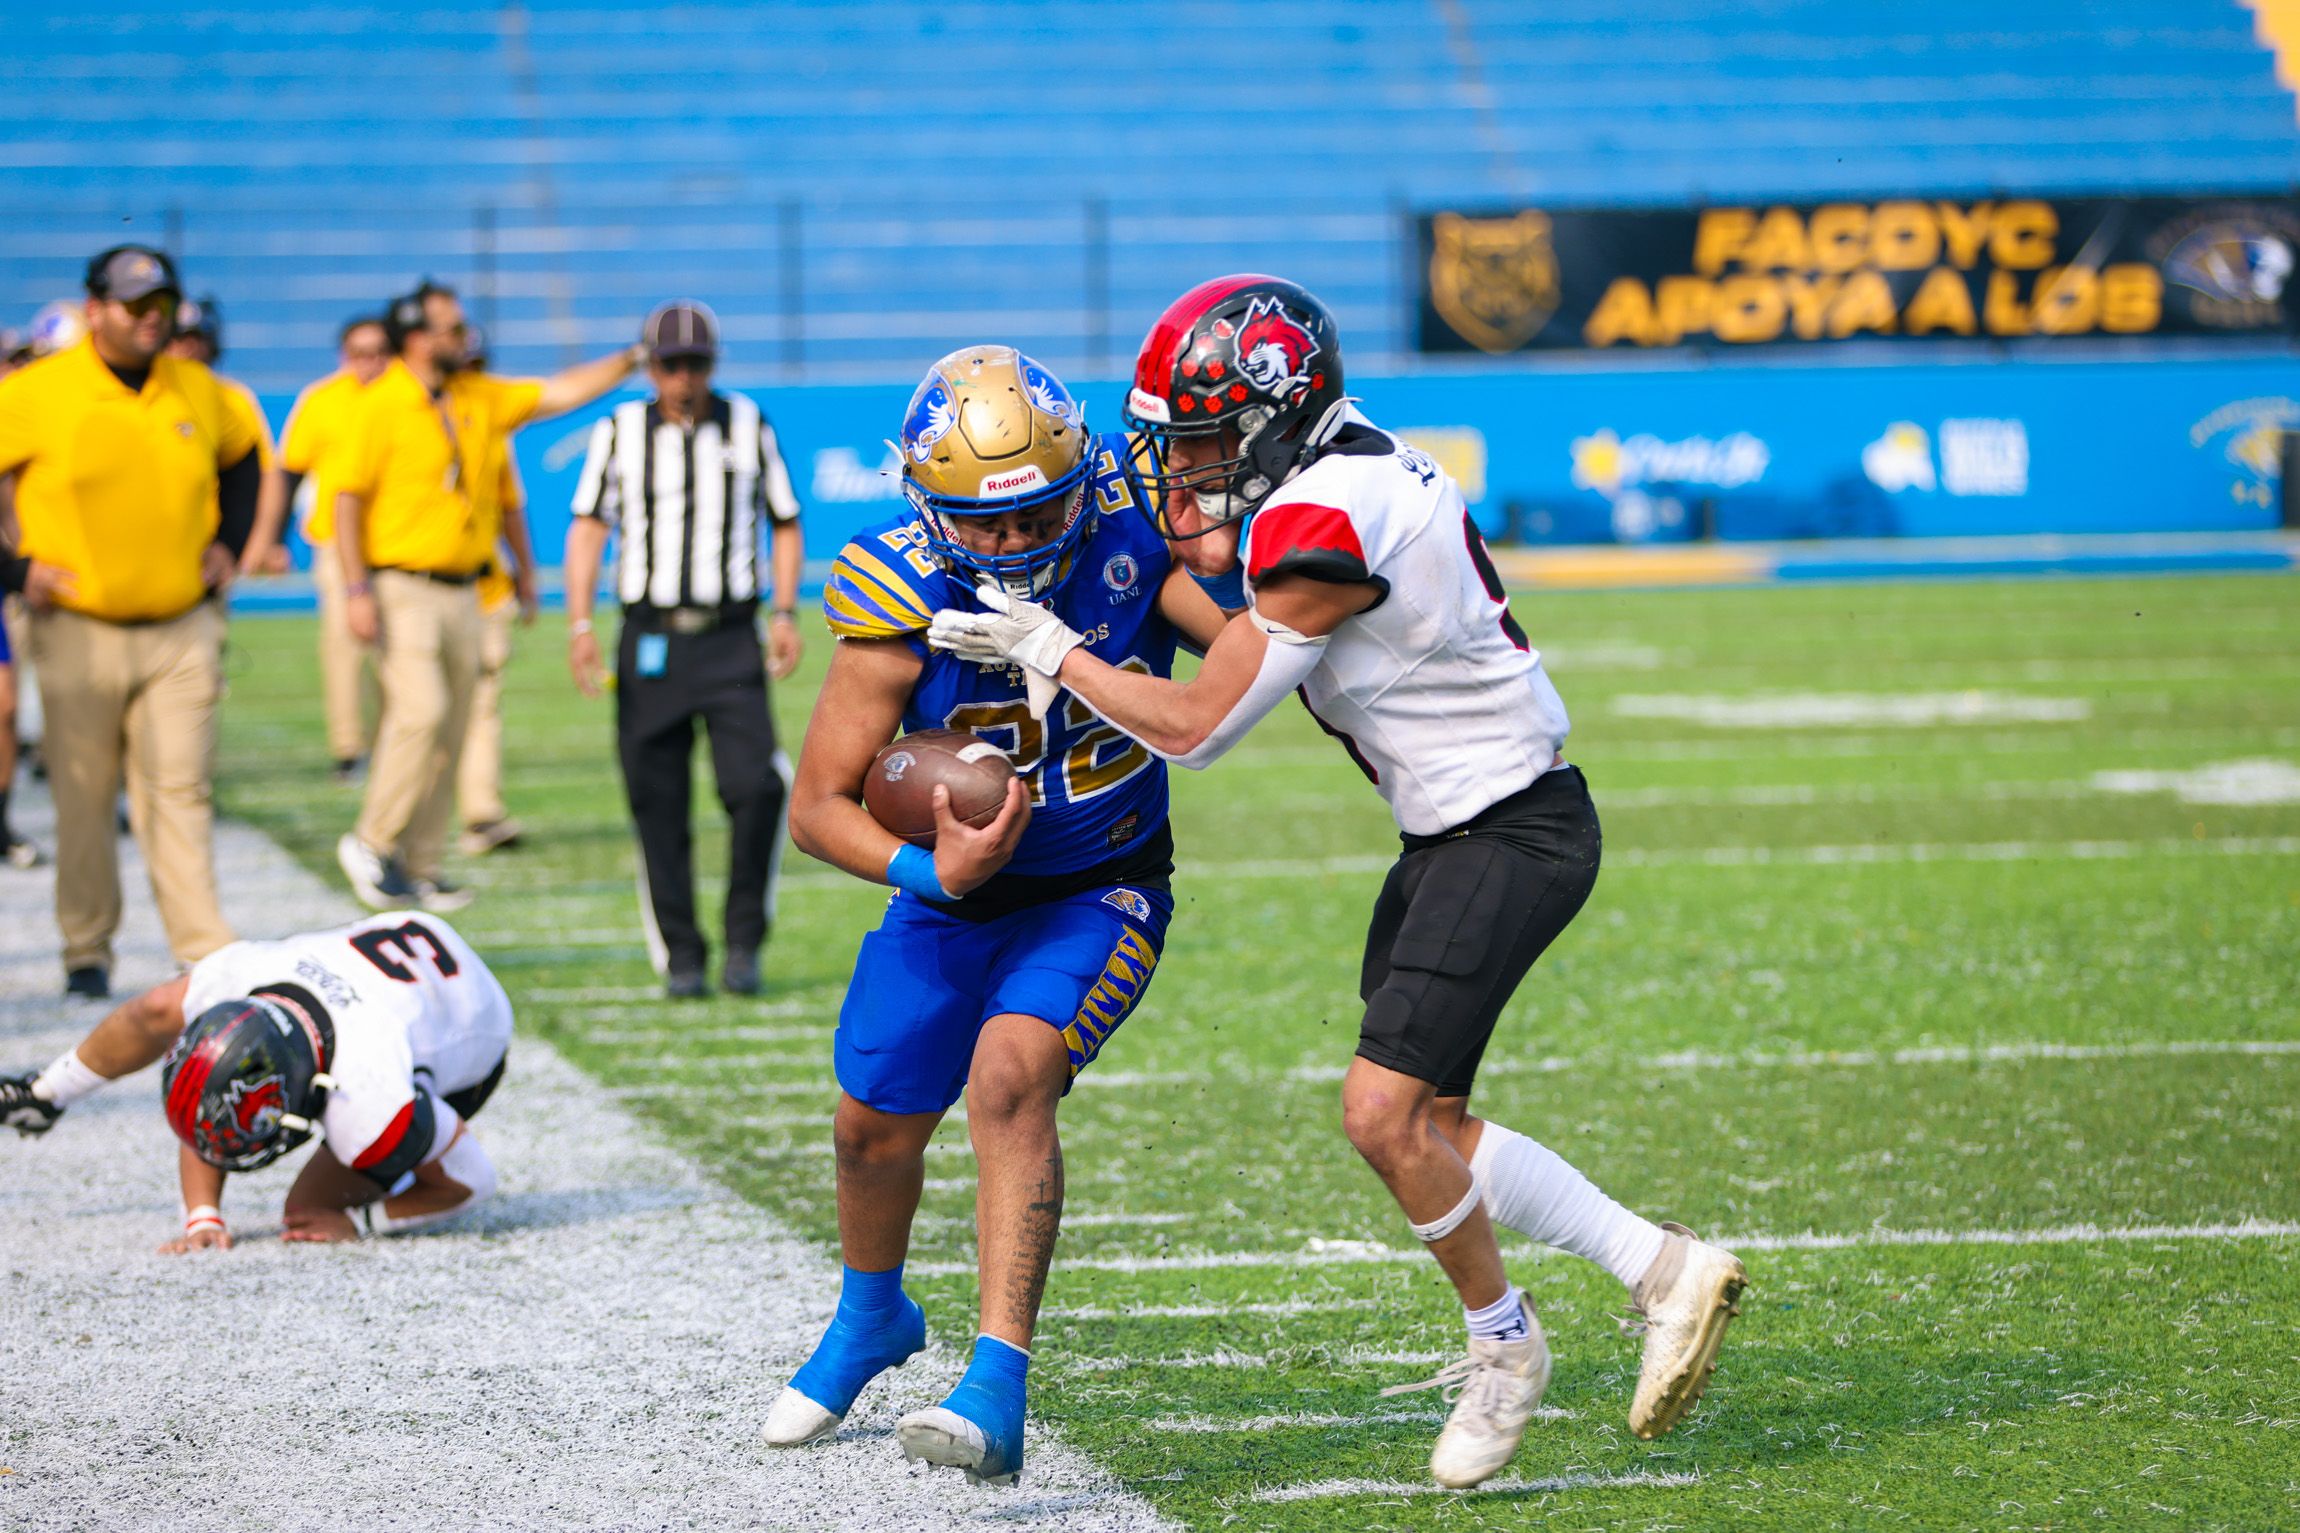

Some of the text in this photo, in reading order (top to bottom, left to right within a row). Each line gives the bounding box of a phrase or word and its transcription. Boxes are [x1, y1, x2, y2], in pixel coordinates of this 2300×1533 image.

[1583, 270, 1894, 346] APOYA
[1906, 268, 1977, 336] A
[1984, 262, 2163, 336] LOS
[987, 471, 1036, 491] Riddell
[1062, 492, 1085, 532] Riddell
[1109, 586, 1142, 605] UANL
[349, 919, 460, 983] 3
